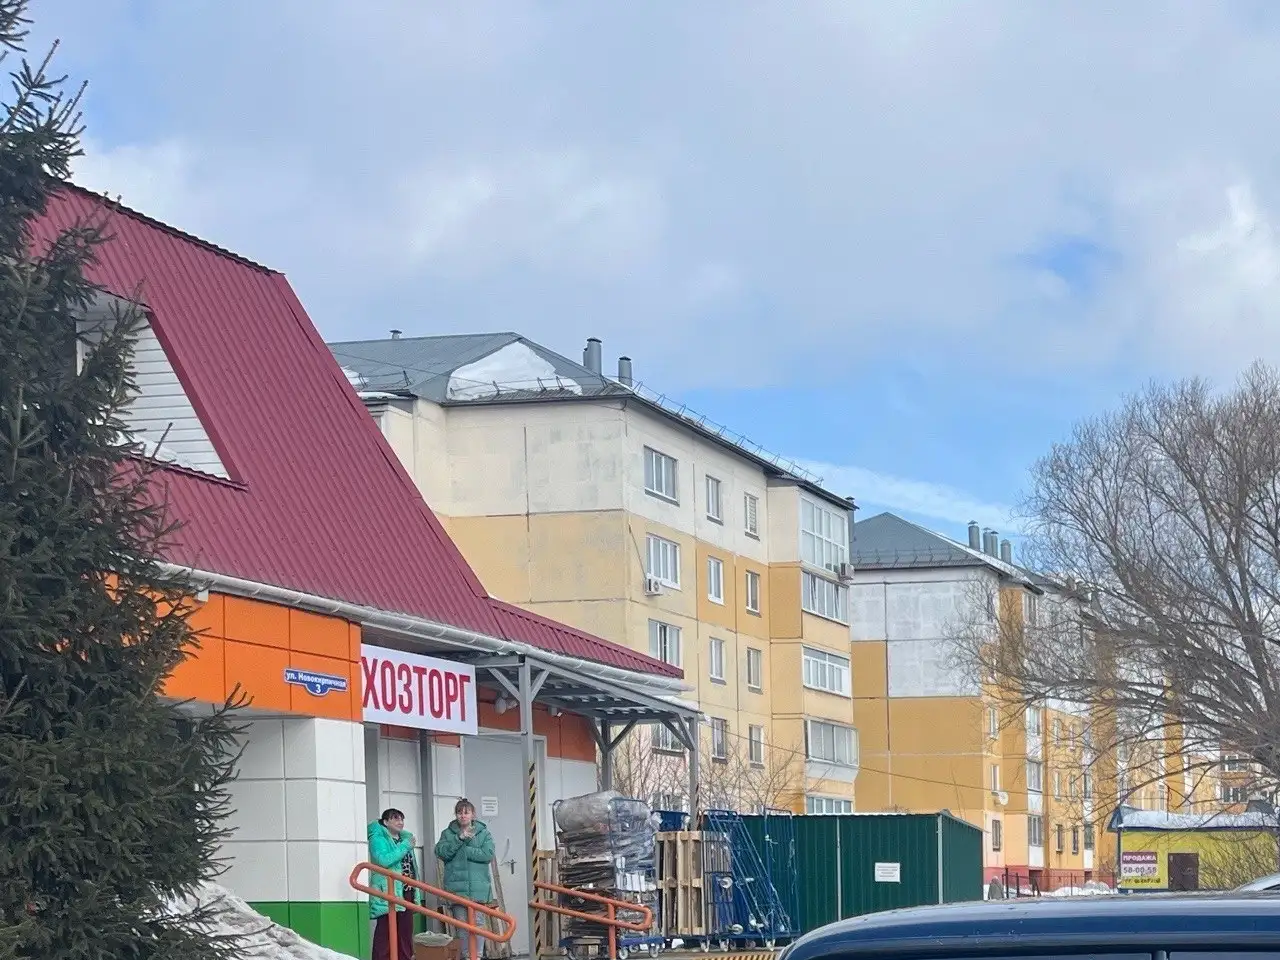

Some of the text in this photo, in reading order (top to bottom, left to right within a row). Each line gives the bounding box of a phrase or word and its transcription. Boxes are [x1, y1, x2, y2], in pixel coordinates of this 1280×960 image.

[286, 672, 297, 681] ул.
[315, 683, 322, 694] 3
[361, 656, 470, 721] ХОЗТОРГ
